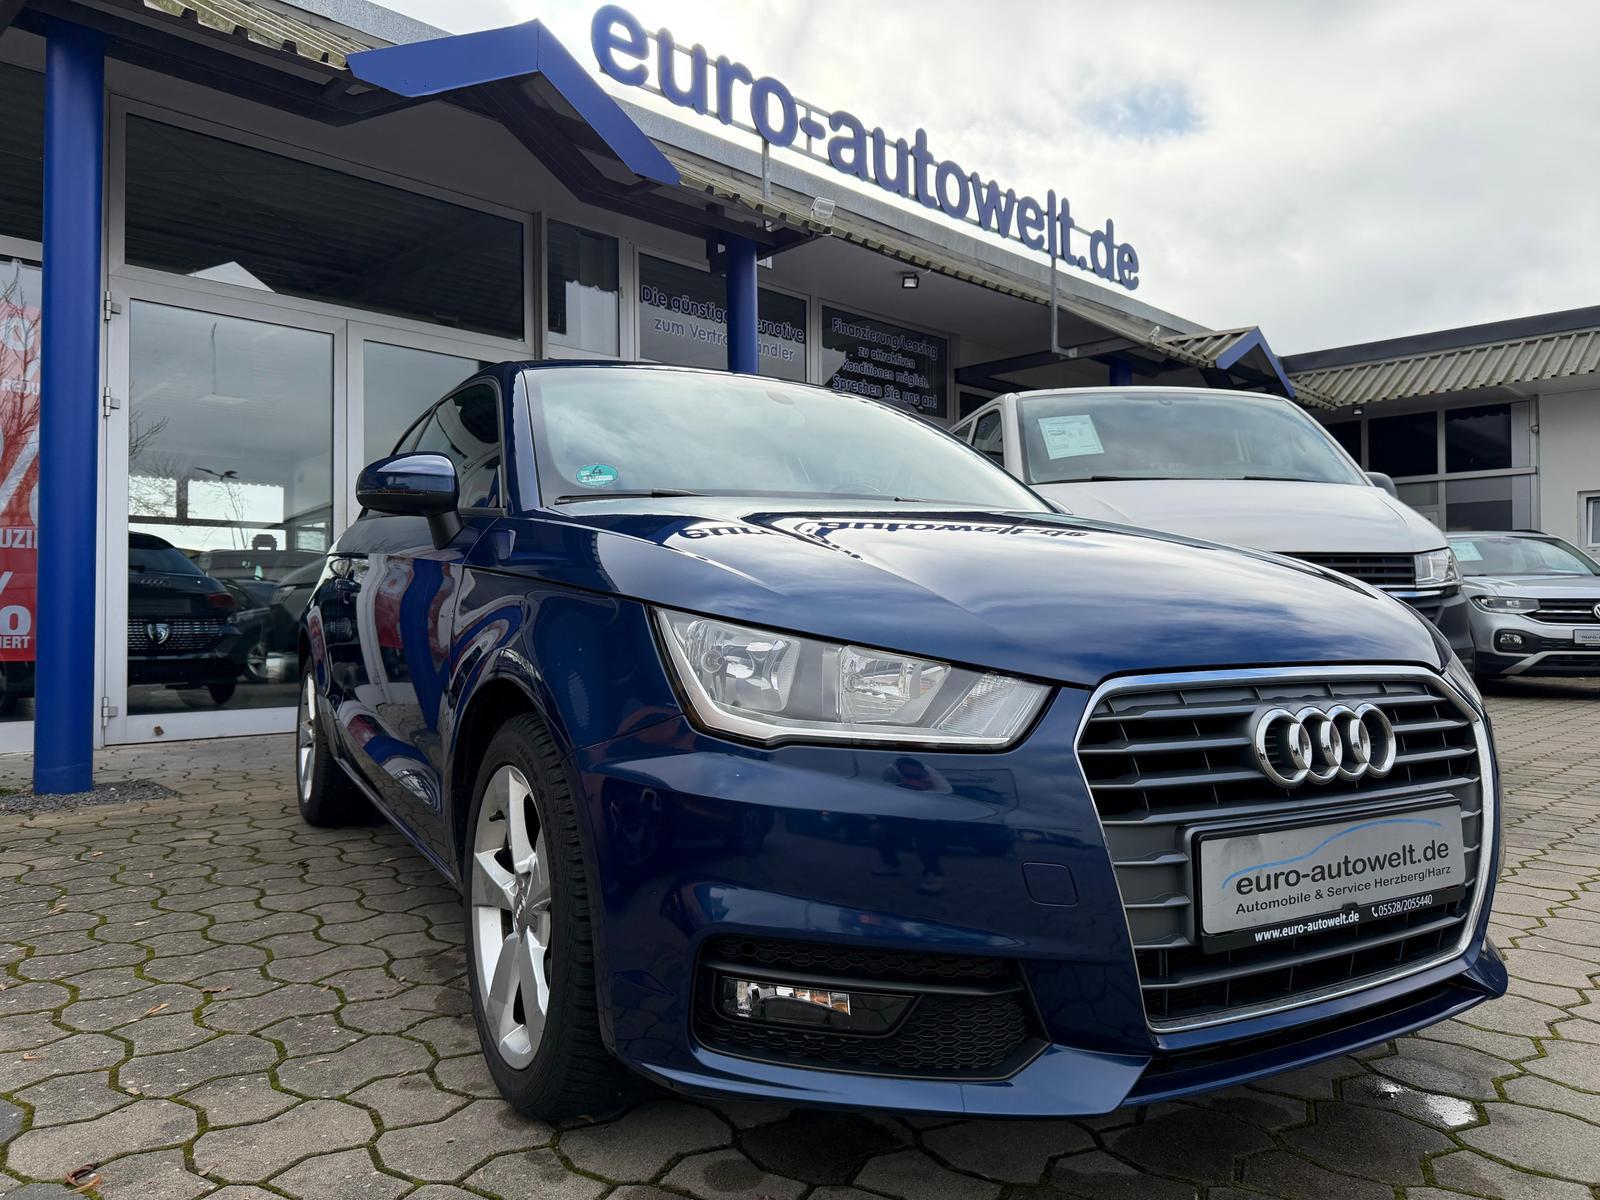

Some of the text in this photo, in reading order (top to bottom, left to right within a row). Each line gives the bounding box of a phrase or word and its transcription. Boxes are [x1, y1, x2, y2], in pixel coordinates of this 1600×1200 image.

[591, 4, 1139, 290] euro-autowelt.de
[641, 285, 667, 306] Die
[654, 317, 685, 336] zum
[832, 317, 937, 360] Finanzierung/Leasing
[843, 358, 894, 380] Konditionen
[858, 347, 915, 369] zu attraktiven
[832, 374, 937, 409] Sprechen Sie uns an!
[1235, 839, 1450, 895] euro-autowelt.de
[1235, 865, 1452, 915] Automobile & Service Herzberg/Harz
[1254, 895, 1433, 942] www.euro-autowelt.de 05528/2055440
